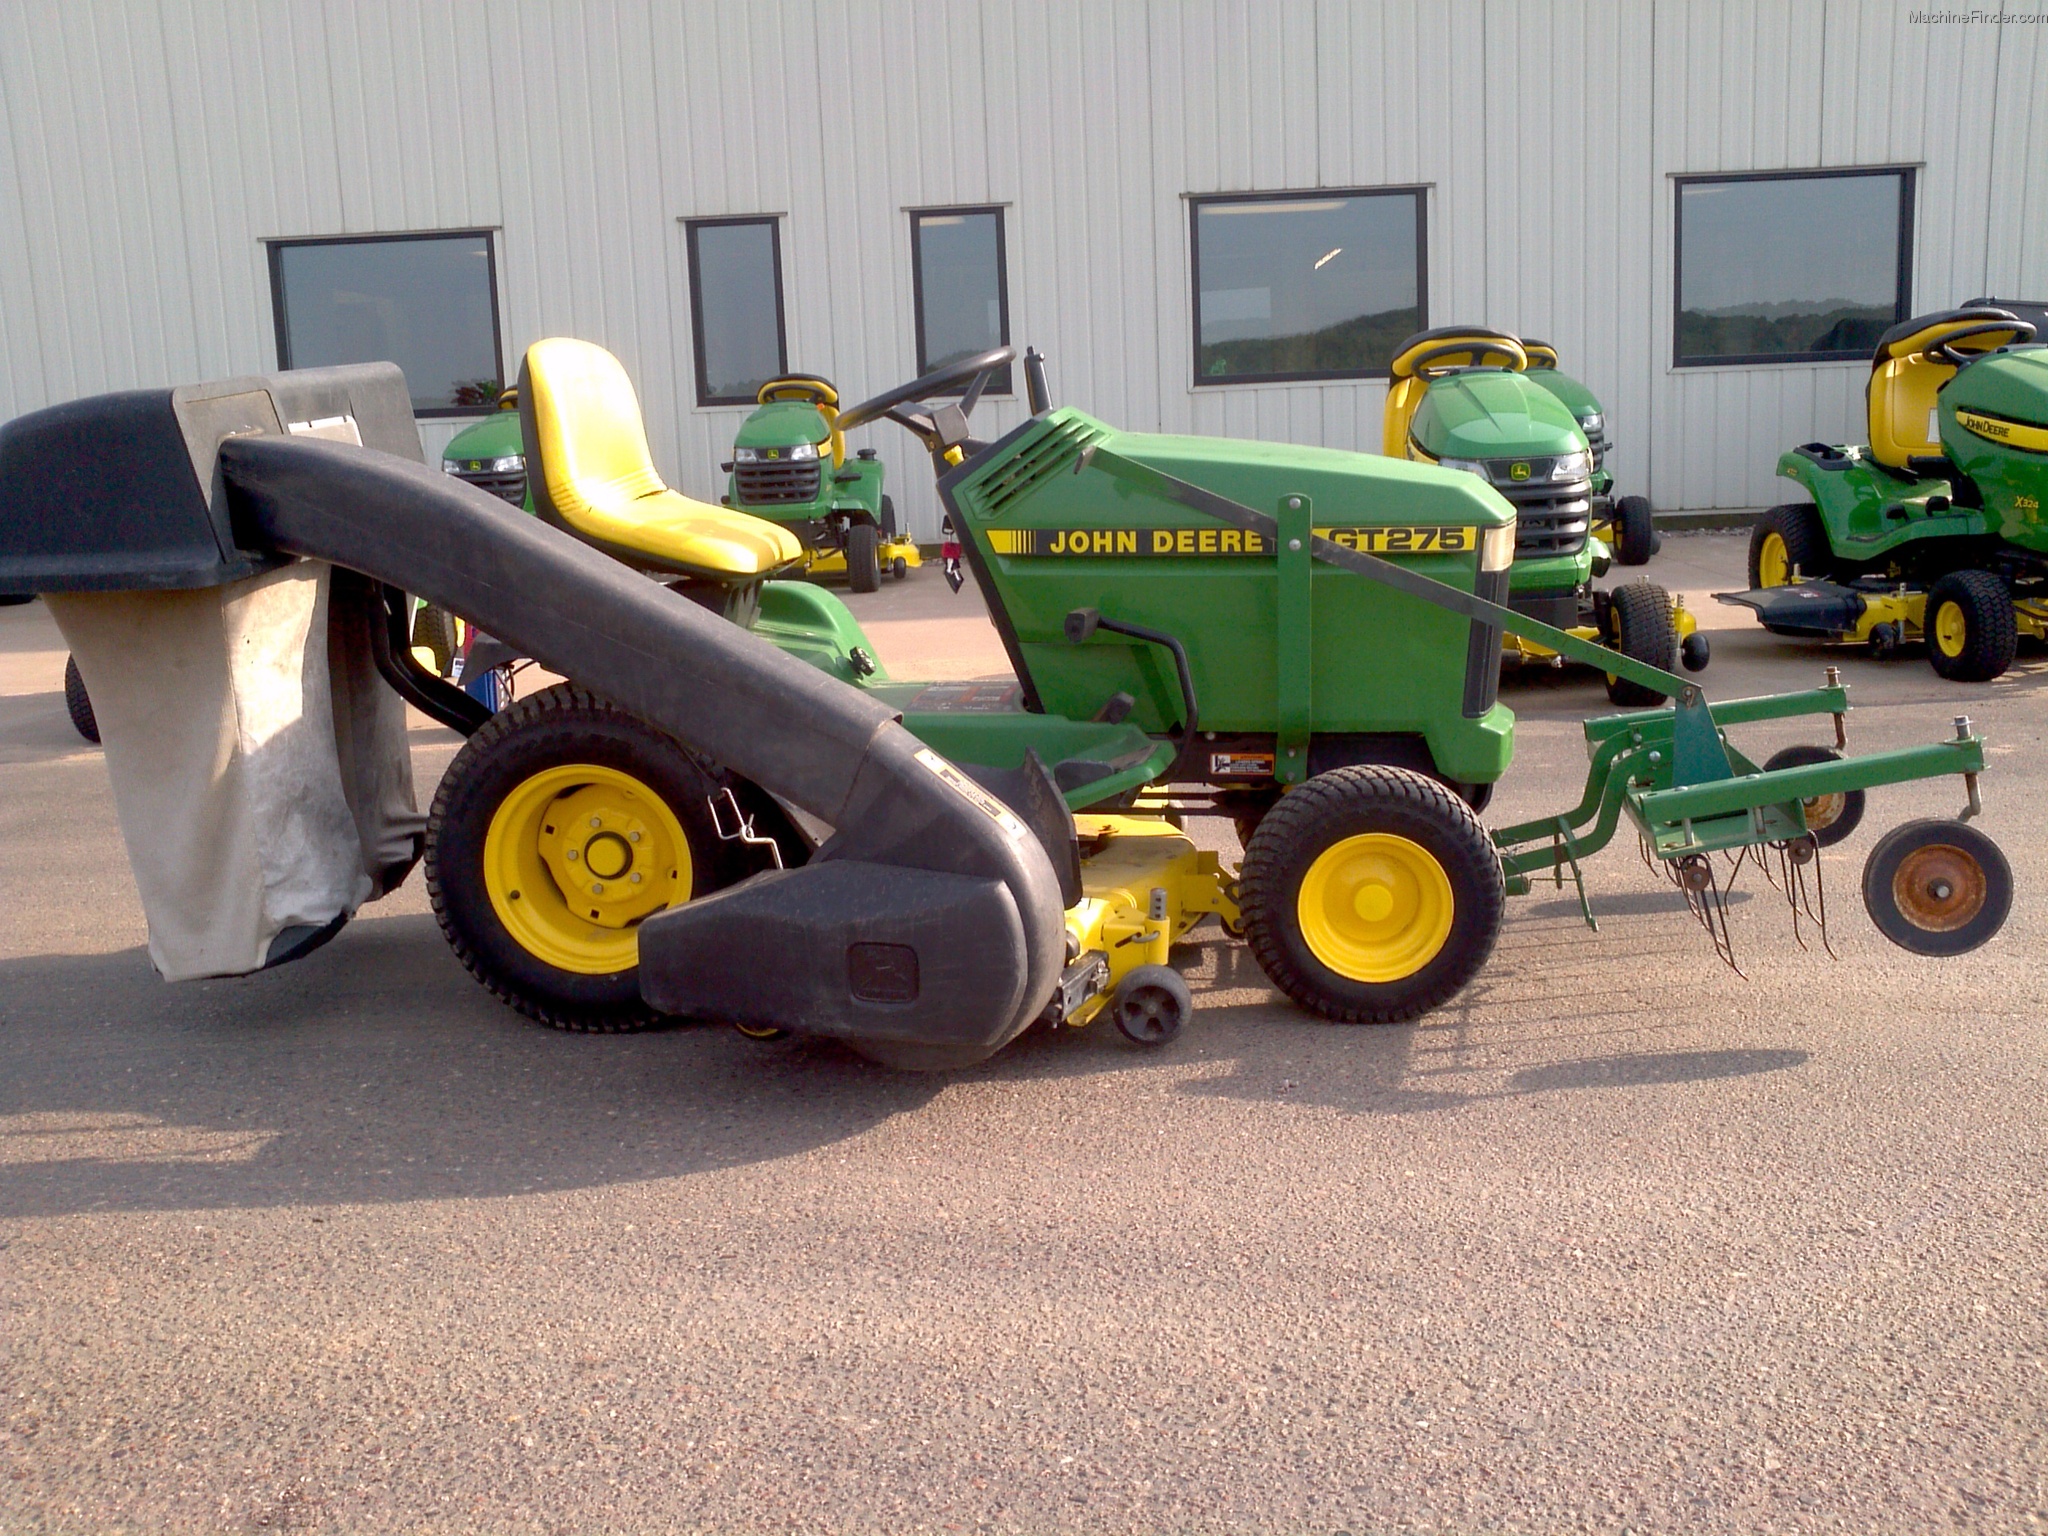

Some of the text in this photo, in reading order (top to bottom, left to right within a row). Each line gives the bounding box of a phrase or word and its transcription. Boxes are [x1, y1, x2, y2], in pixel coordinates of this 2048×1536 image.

[1966, 416, 2010, 438] JOHN DEERE
[2014, 495, 2039, 509] X324
[1050, 529, 1264, 554] JOHN DEERE
[1329, 527, 1465, 551] GT275
